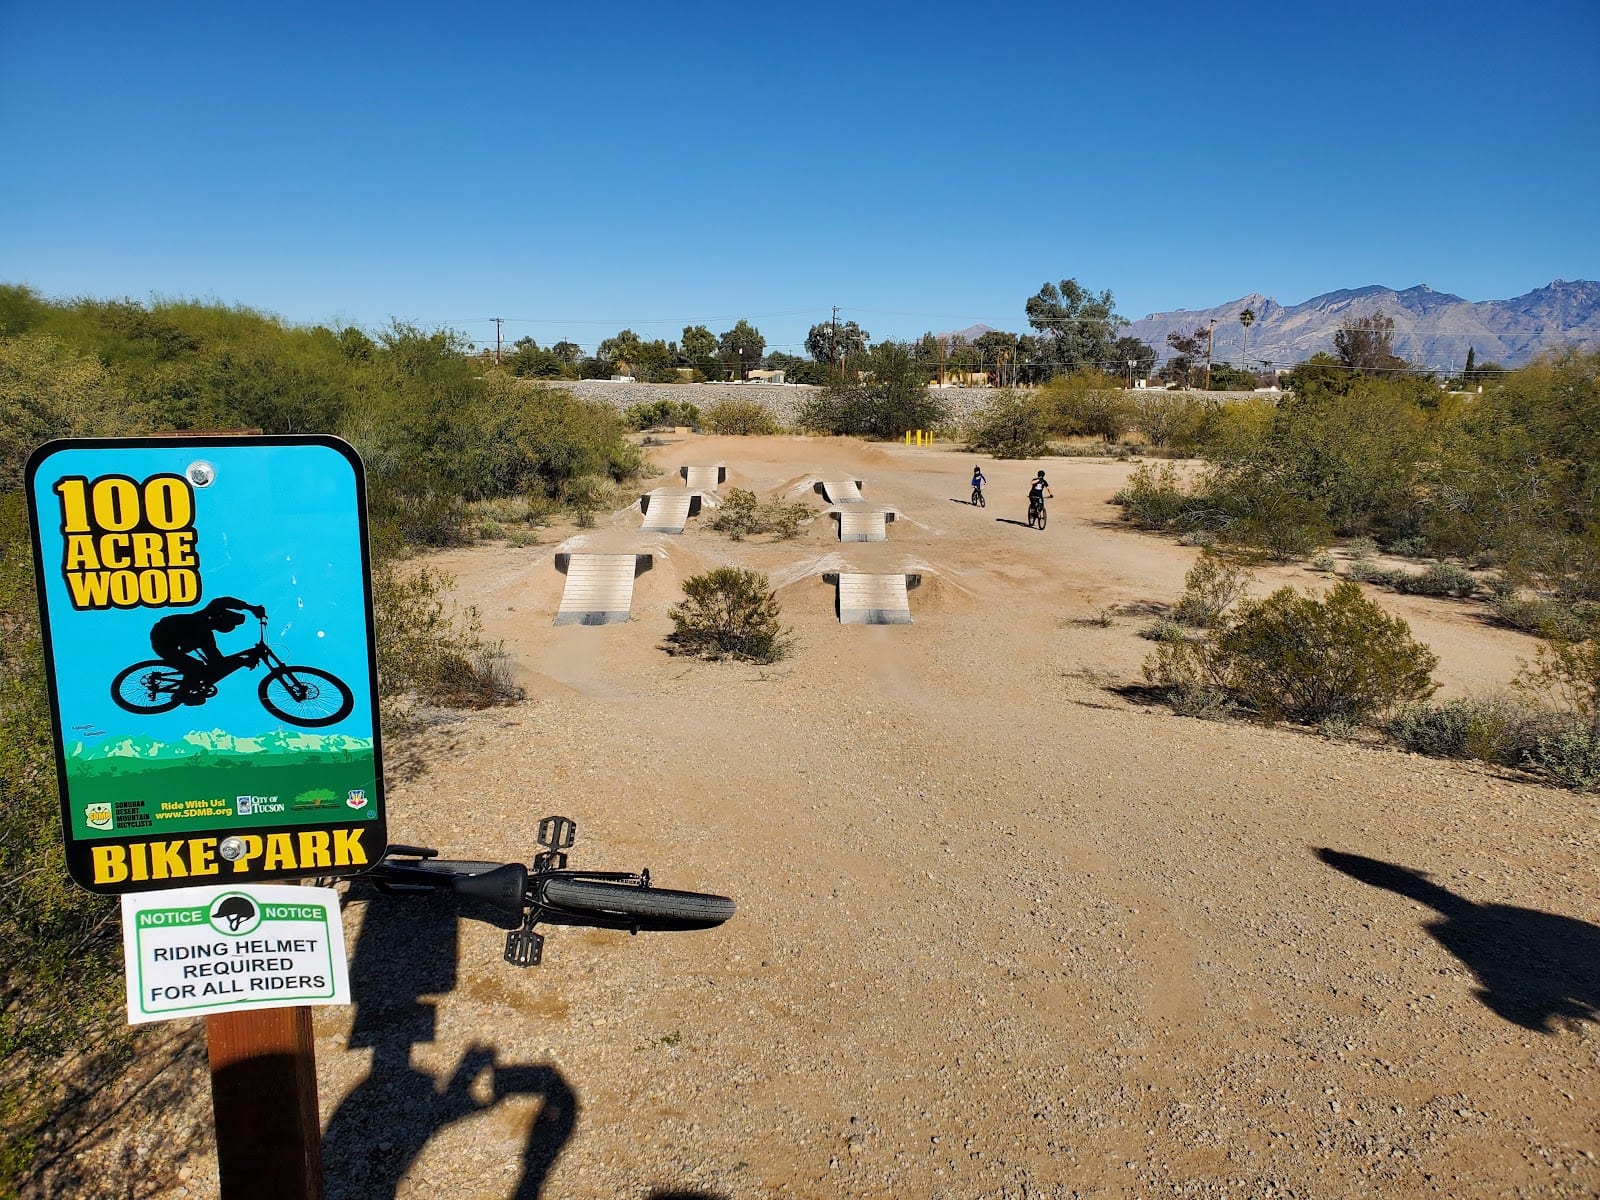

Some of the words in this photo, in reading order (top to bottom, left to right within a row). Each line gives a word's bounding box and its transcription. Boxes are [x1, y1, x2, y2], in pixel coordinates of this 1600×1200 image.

[58, 477, 191, 532] 100
[66, 532, 195, 570] ACRE
[67, 569, 198, 607] WOOD
[155, 807, 233, 820] www.SDMB.org
[161, 802, 184, 811] Ride
[185, 800, 208, 809] With
[210, 799, 226, 807] Us!
[252, 803, 285, 813] TUCSON
[116, 814, 150, 822] MOUNTAIN
[117, 820, 153, 829] BICYCLISTS
[91, 838, 218, 884] BIKE
[232, 828, 368, 873] PARK
[140, 910, 203, 925] NOTICE
[265, 907, 322, 919] NOTICE
[153, 942, 228, 961] RIDING
[236, 939, 318, 955] HELMET
[183, 958, 294, 979] REQUIRED
[151, 984, 196, 1001] FOR
[202, 980, 244, 996] ALL
[250, 975, 325, 991] RIDERS
